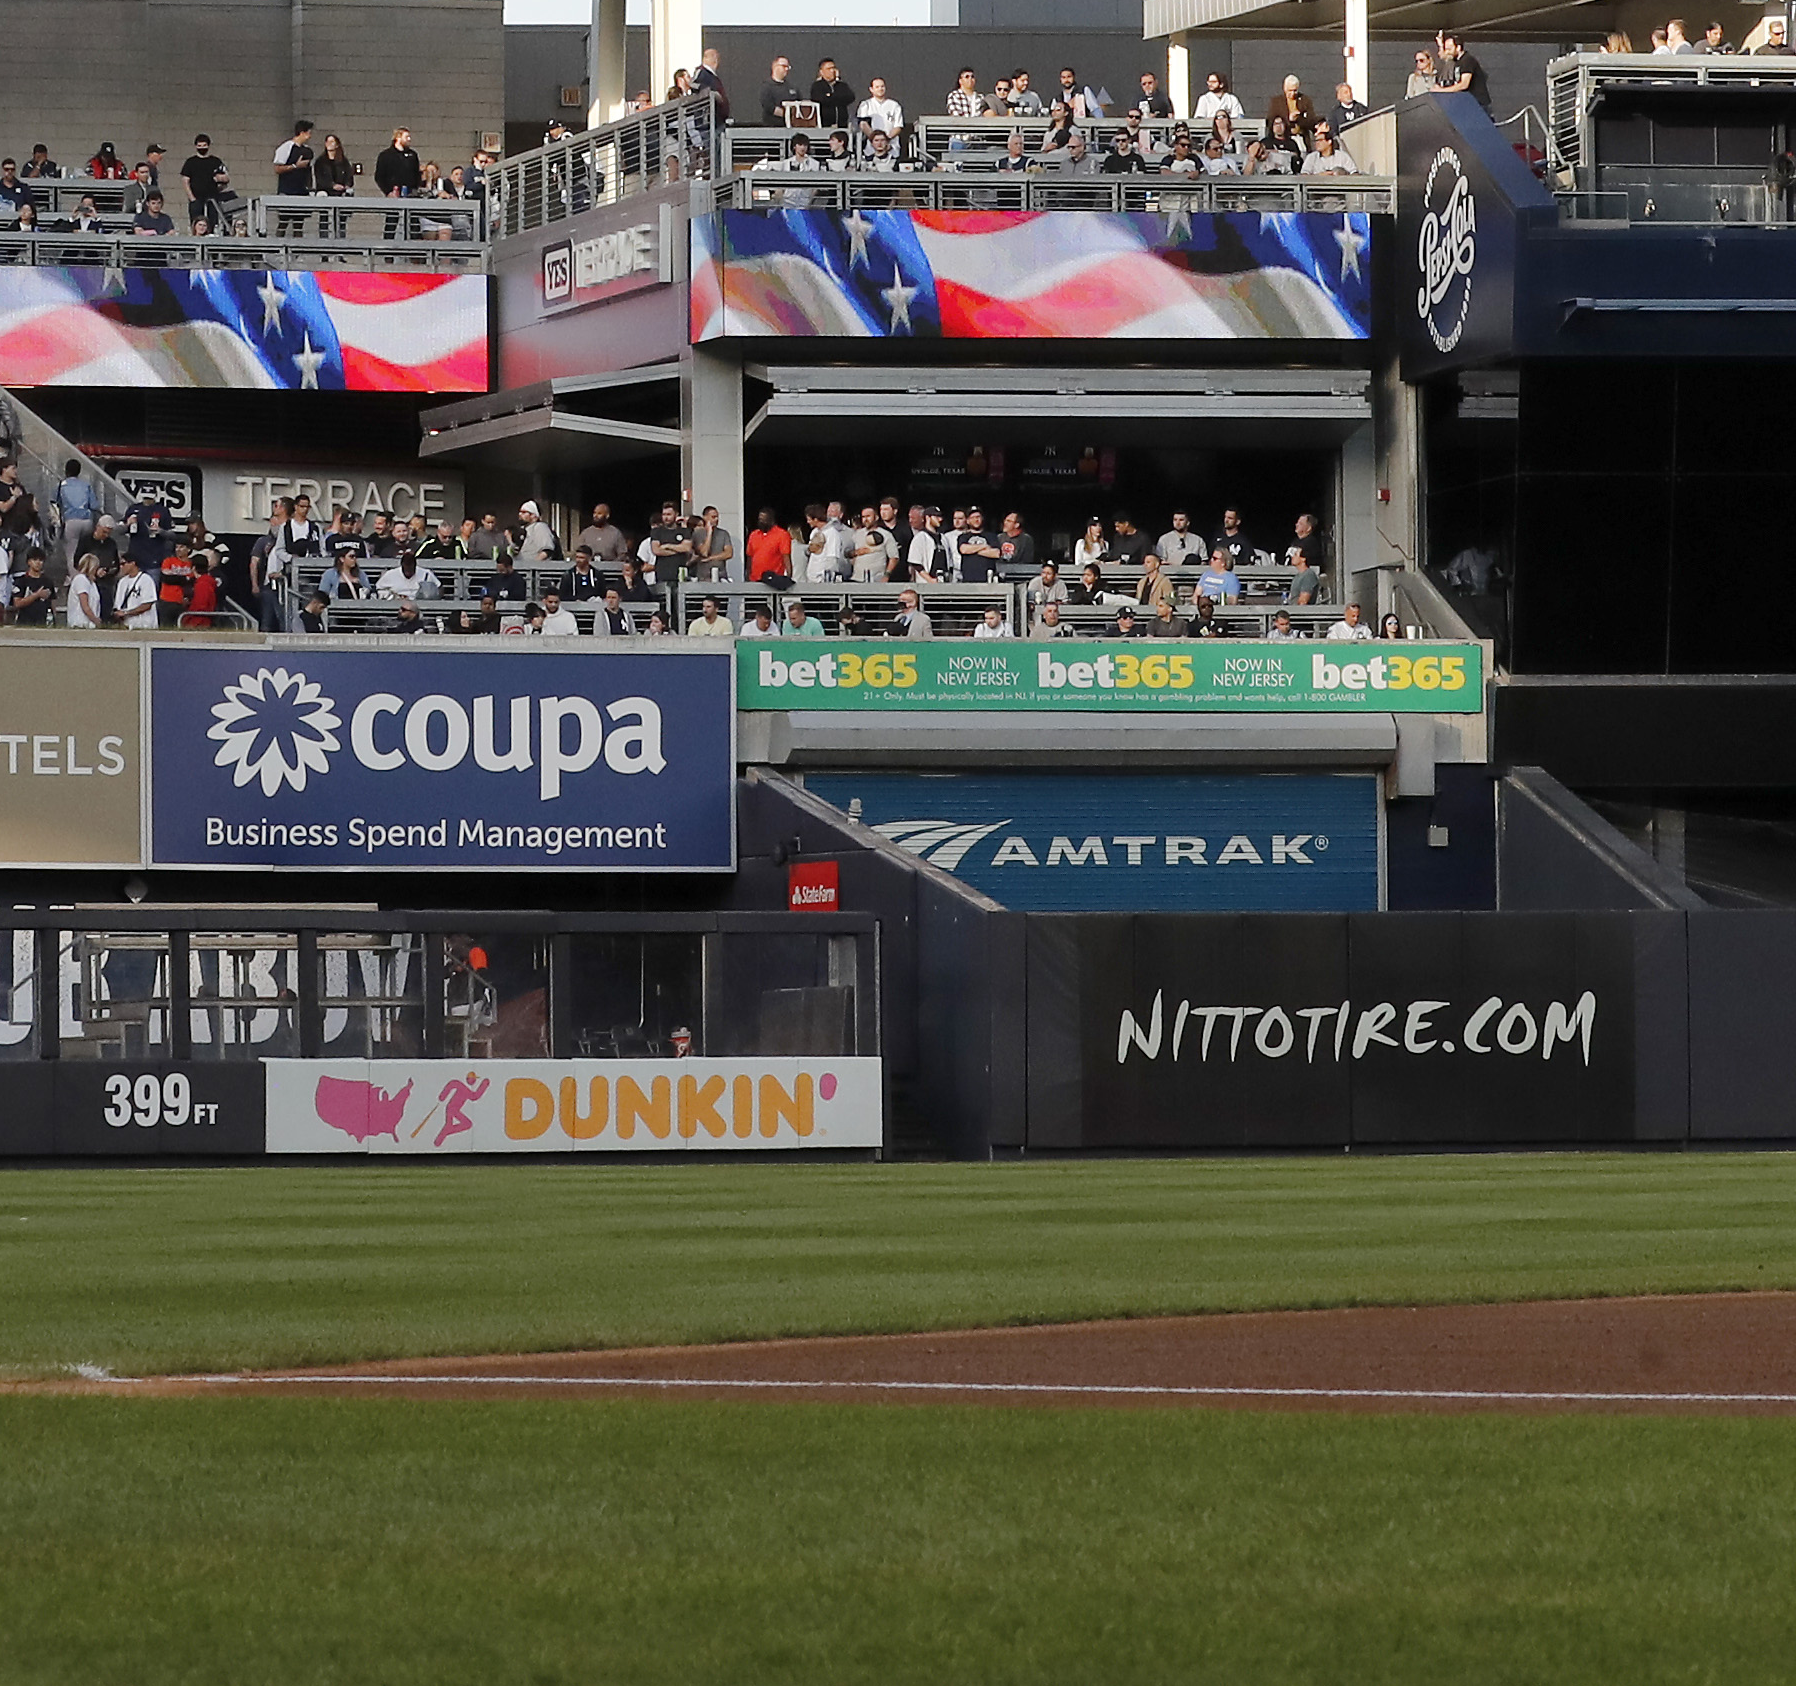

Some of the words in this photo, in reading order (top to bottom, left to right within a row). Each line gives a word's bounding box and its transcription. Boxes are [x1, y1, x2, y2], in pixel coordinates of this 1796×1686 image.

[236, 476, 446, 526] TERRACE
[759, 651, 919, 689] bet365
[937, 672, 971, 686] NEW
[973, 671, 1021, 687] JERSEY
[949, 657, 989, 671] NOW
[992, 657, 1007, 670] IN
[1037, 652, 1195, 689] bet365
[1212, 673, 1247, 687] NEW
[1249, 673, 1296, 688] JERSEY
[1225, 658, 1264, 672] NOW
[1266, 658, 1283, 672] IN
[1311, 654, 1467, 690] bet365
[351, 692, 668, 802] coupa
[205, 816, 339, 847] Business
[347, 816, 447, 854] Spend
[457, 819, 668, 856] Management
[990, 833, 1314, 867] AMTRAK
[1118, 988, 1597, 1067] NITTOTIRE.COM
[104, 1072, 192, 1128] 399
[194, 1103, 220, 1125] FT
[503, 1072, 837, 1141] DUNKIN'
